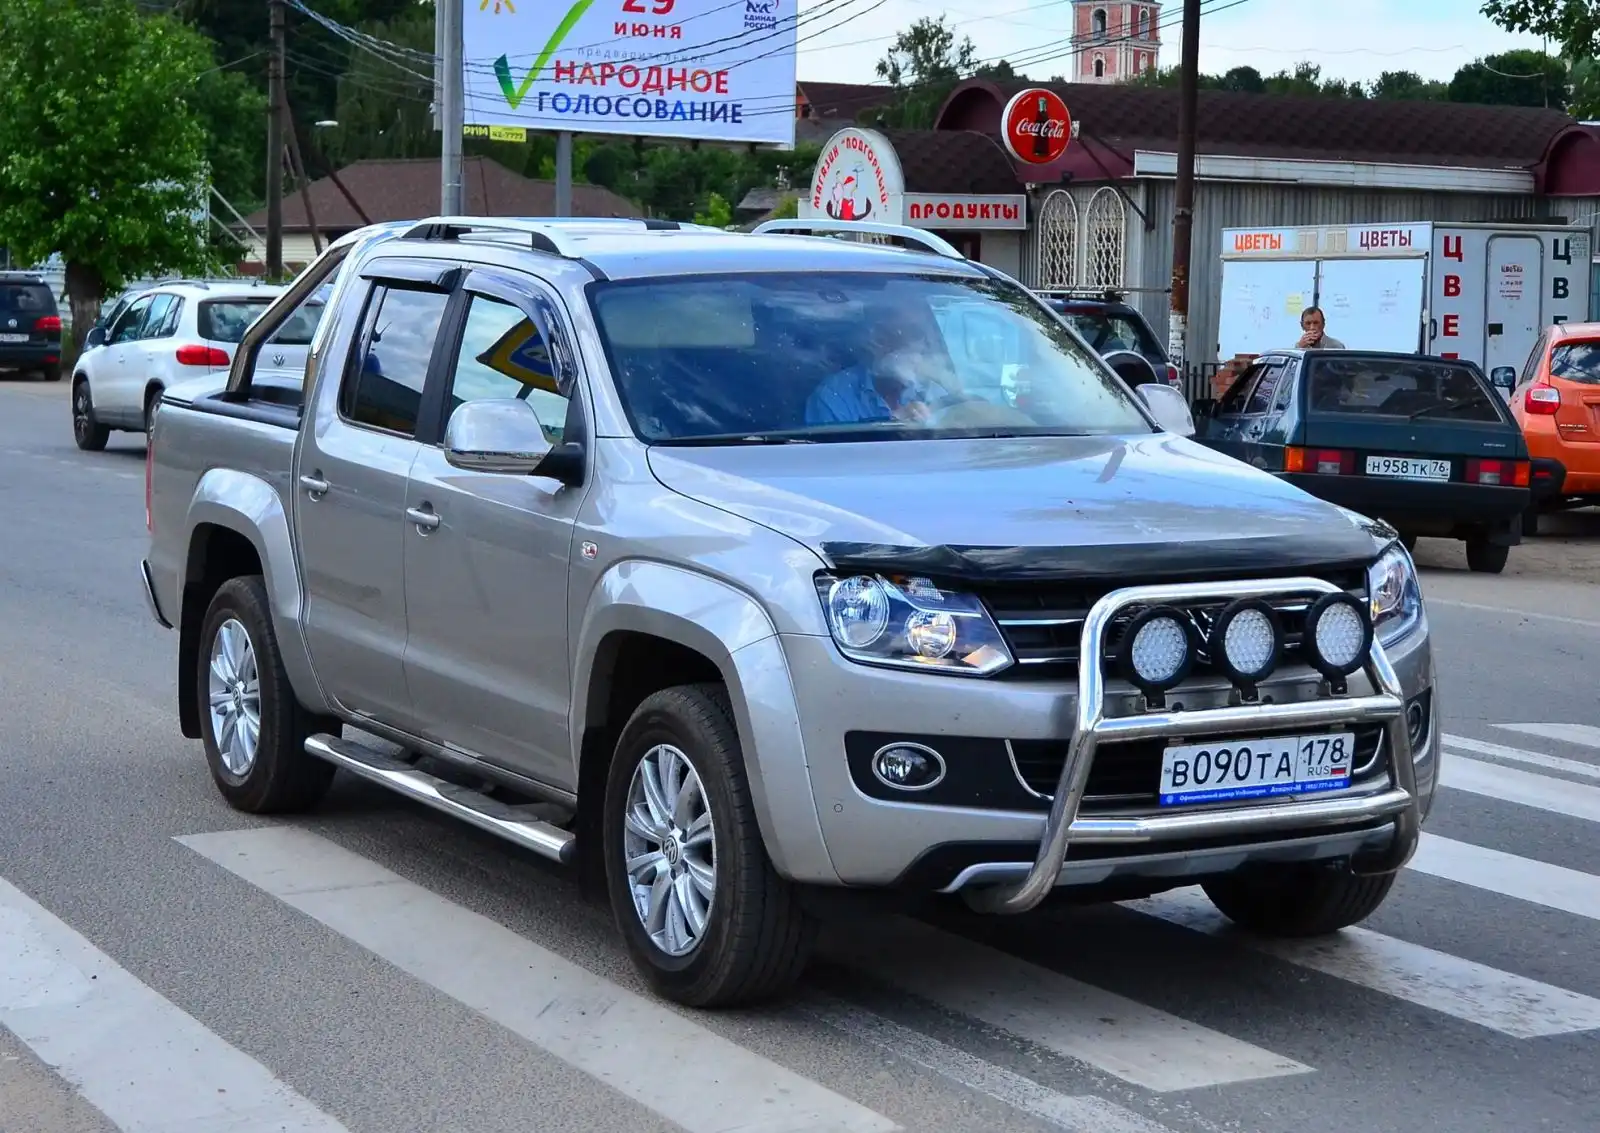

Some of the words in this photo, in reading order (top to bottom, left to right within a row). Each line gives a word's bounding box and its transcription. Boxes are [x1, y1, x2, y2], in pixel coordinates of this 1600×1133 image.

[743, 21, 777, 30] РОССИЯ
[744, 14, 777, 22] ЕДИНАЯ
[554, 60, 729, 96] НАРОДНОЕ
[537, 92, 743, 124] ГОЛОСОВАНИЕ
[1016, 117, 1066, 138] Coca-Cola
[813, 145, 840, 209] МАГАЗИН
[910, 202, 1019, 220] ПРОДУКТЫ
[1234, 233, 1282, 252] ЦВЕТЫ
[1360, 230, 1412, 251] ЦВЕТЫ
[1372, 459, 1428, 475] Н958ТК
[1432, 461, 1446, 473] 76
[1172, 747, 1292, 787] В090ТА
[1302, 738, 1345, 766] 178
[1307, 765, 1330, 776] RUS
